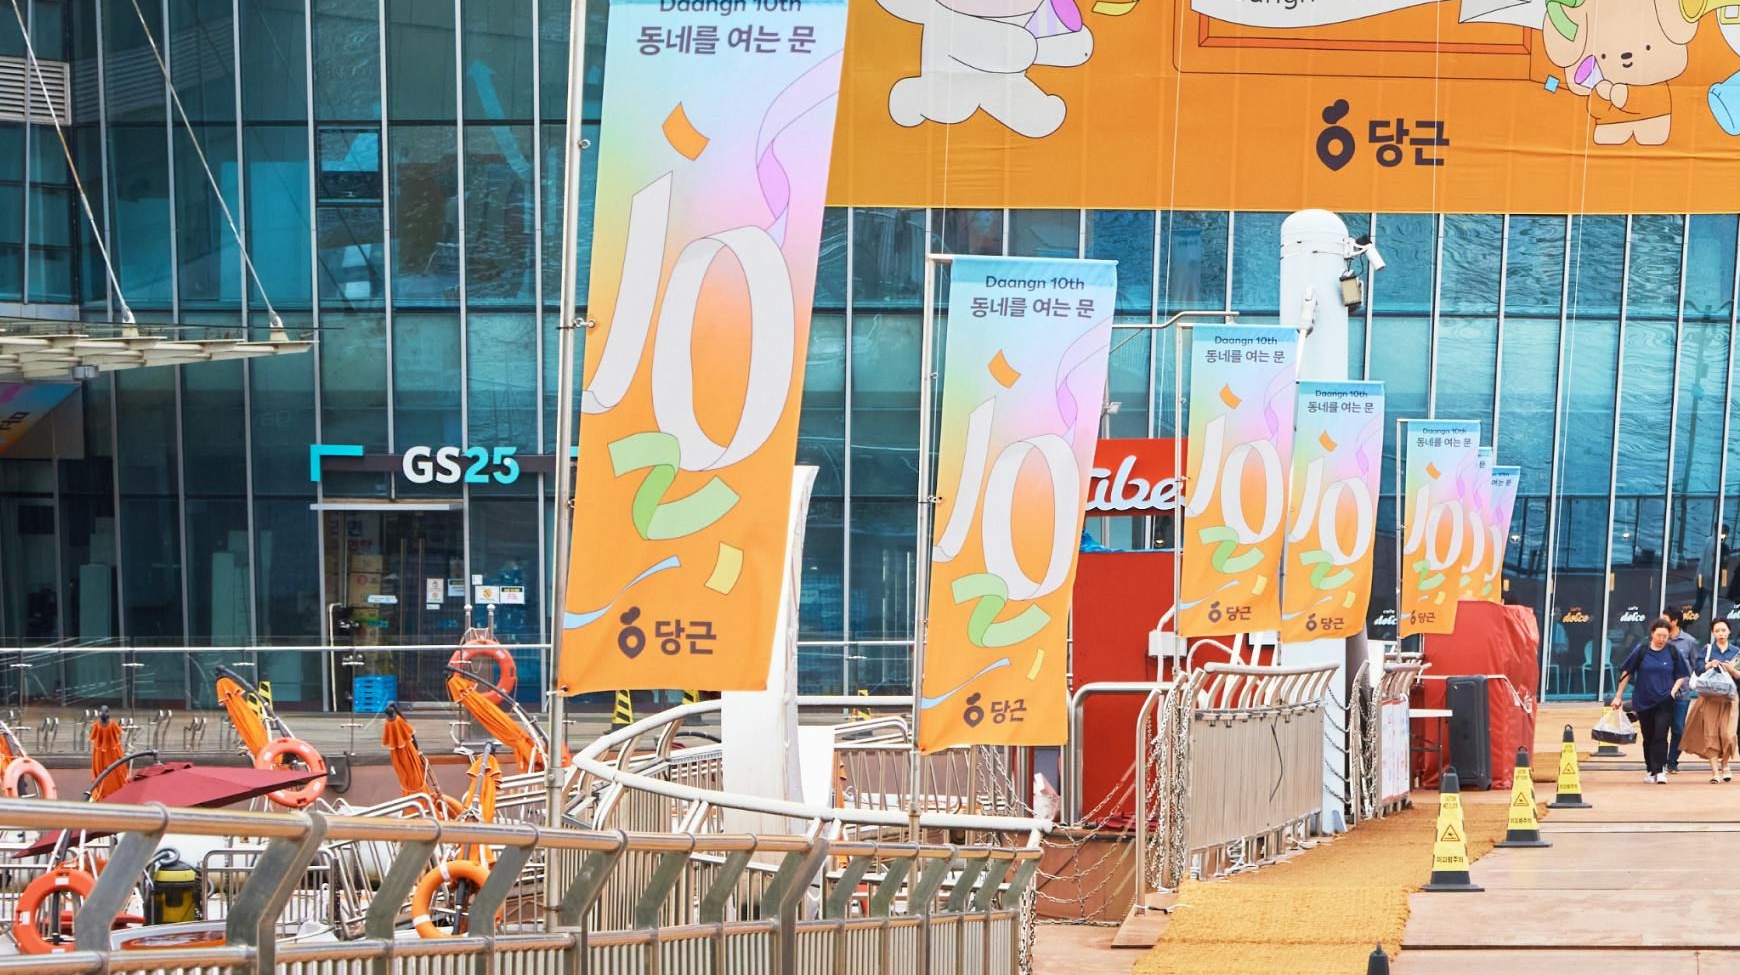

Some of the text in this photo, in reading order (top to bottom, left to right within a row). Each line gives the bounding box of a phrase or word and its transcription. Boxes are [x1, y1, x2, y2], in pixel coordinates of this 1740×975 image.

[637, 25, 817, 56] 동네를 여는 문
[1368, 117, 1450, 167] 당근
[985, 275, 1085, 292] Daangn 10th
[971, 297, 1095, 318] 동네를 여는 문
[1214, 336, 1277, 346] Daangn 10th
[1205, 350, 1285, 364] 동네를 여는 문
[1307, 402, 1374, 414] 동네를 여는 문
[402, 445, 520, 484] GS25
[1226, 606, 1252, 621] 당근
[655, 619, 717, 656] 당근
[990, 699, 1027, 724] 당근
